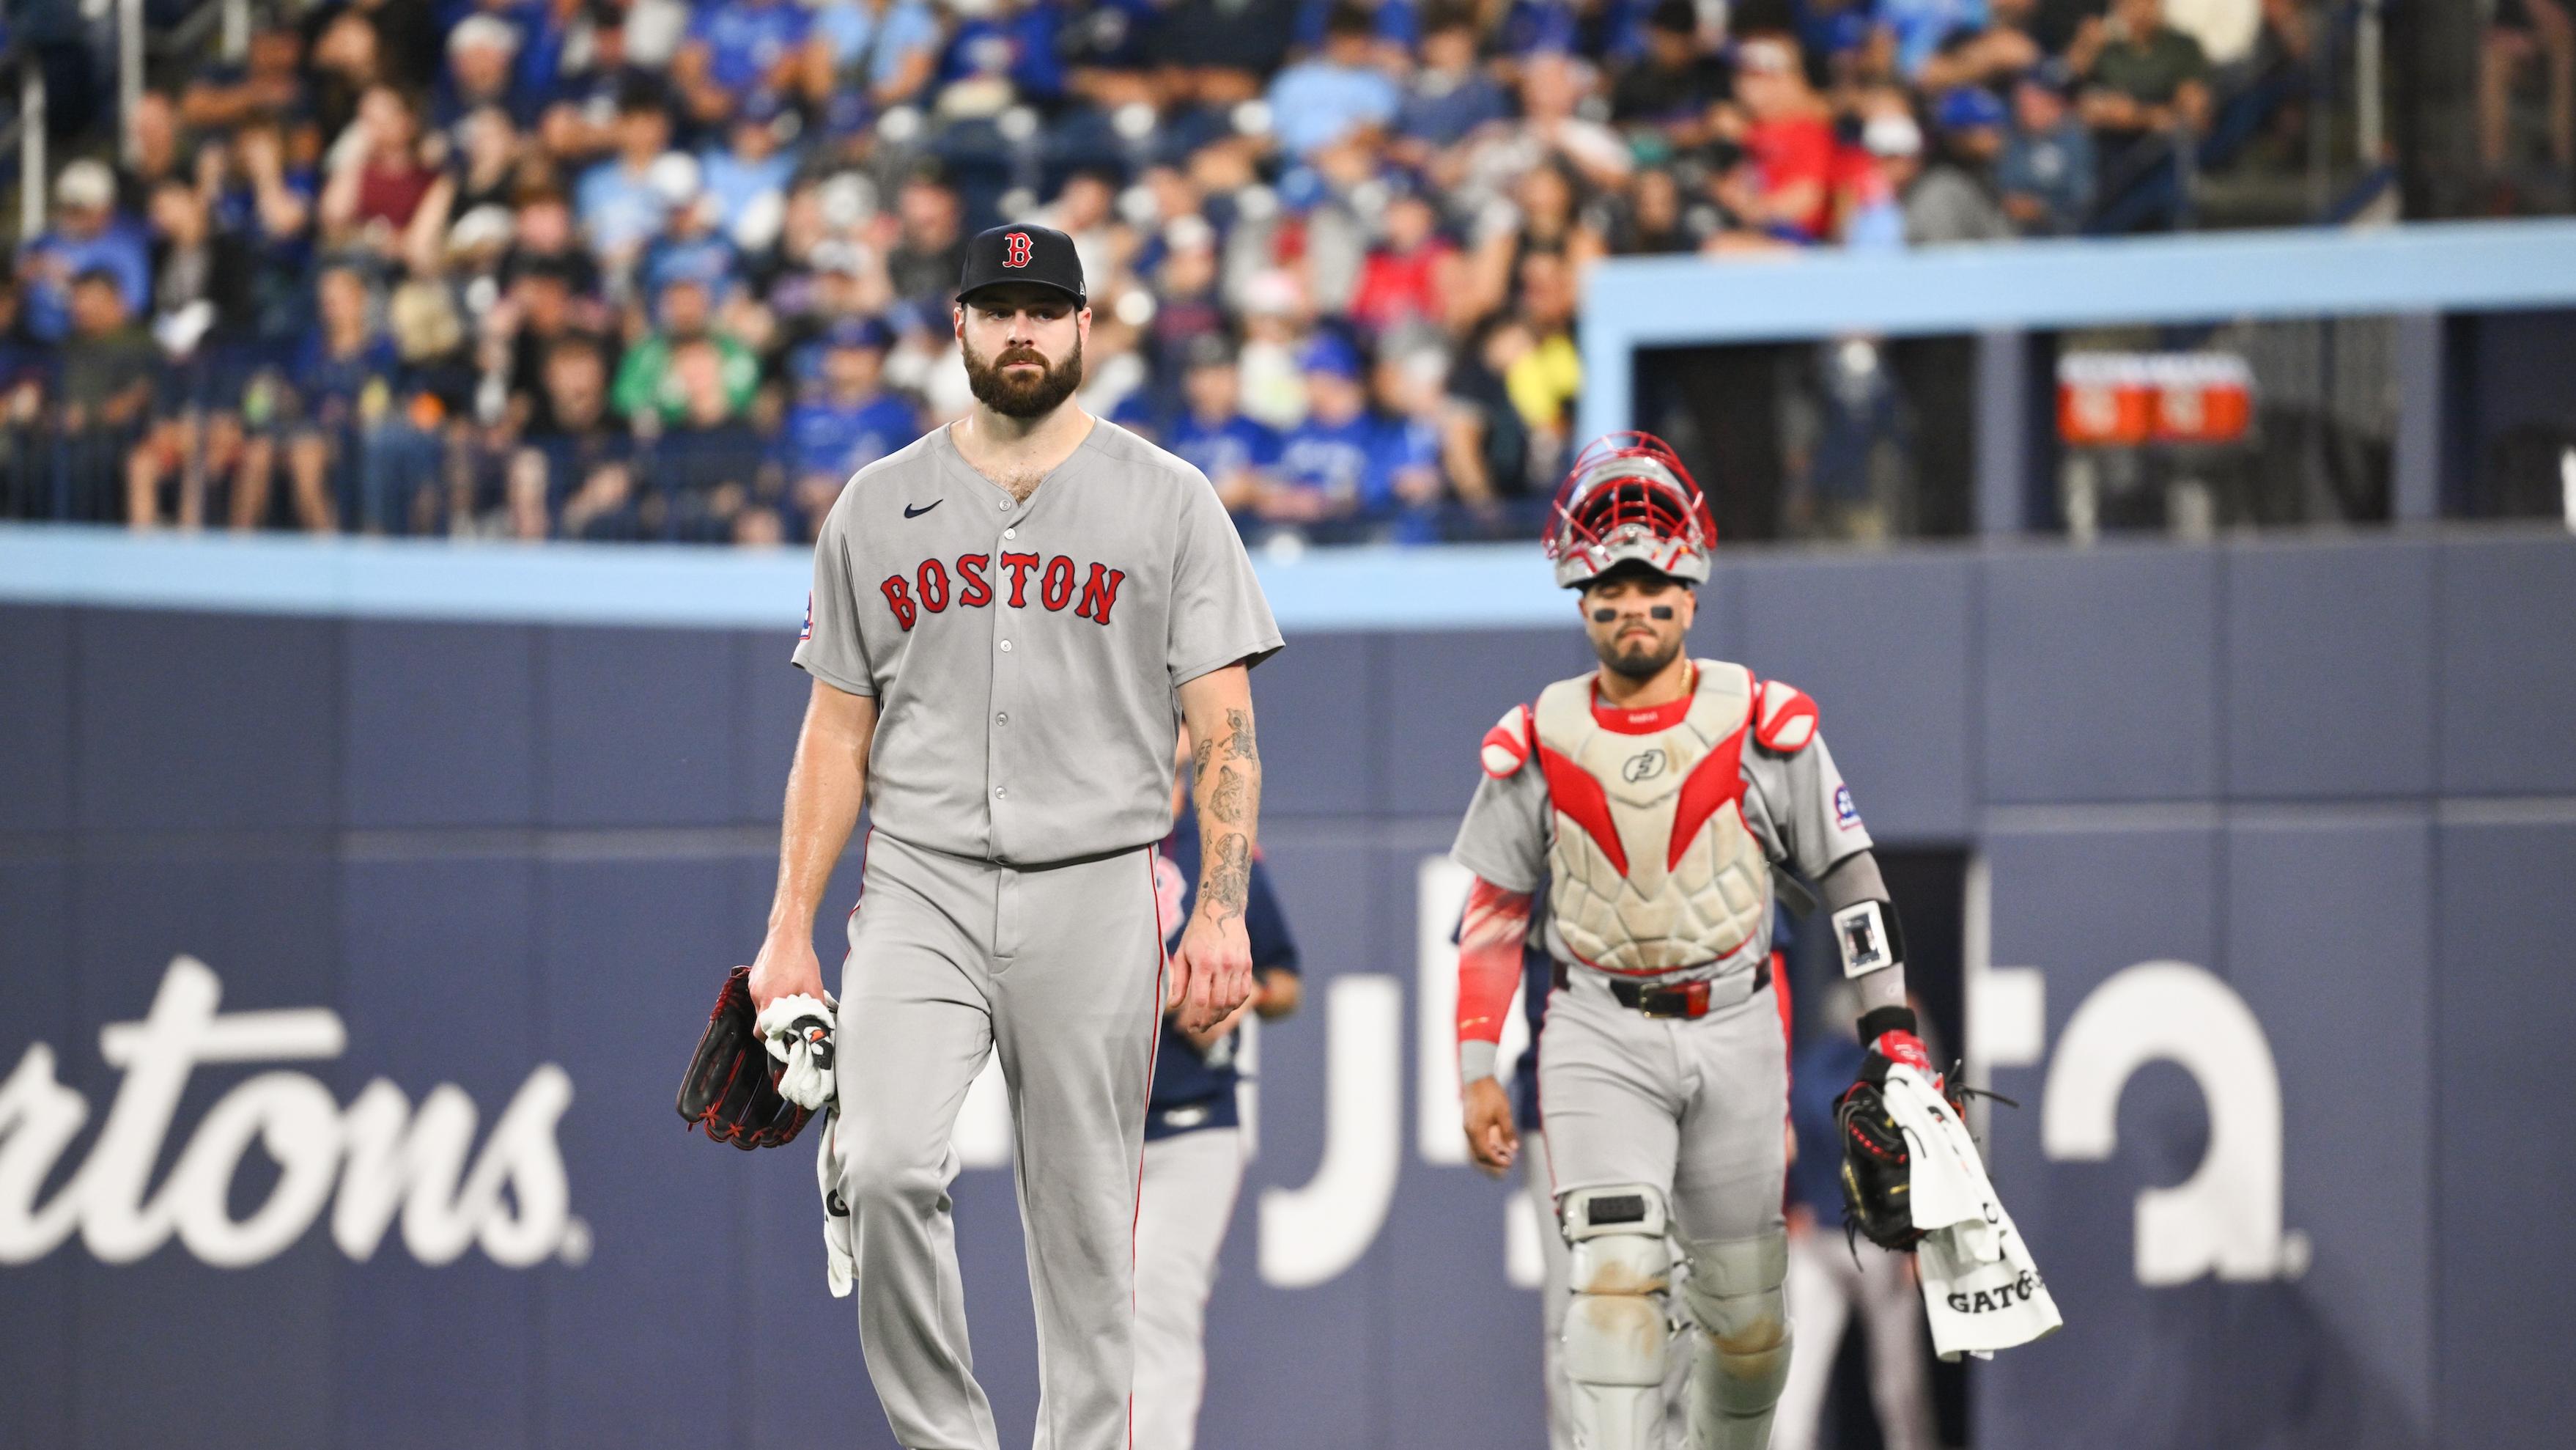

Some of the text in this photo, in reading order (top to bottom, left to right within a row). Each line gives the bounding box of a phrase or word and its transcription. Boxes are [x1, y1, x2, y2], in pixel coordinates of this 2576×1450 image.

[1002, 232, 1034, 268] B
[880, 551, 1126, 632] BOSTON
[1946, 1270, 2042, 1314] GATO
